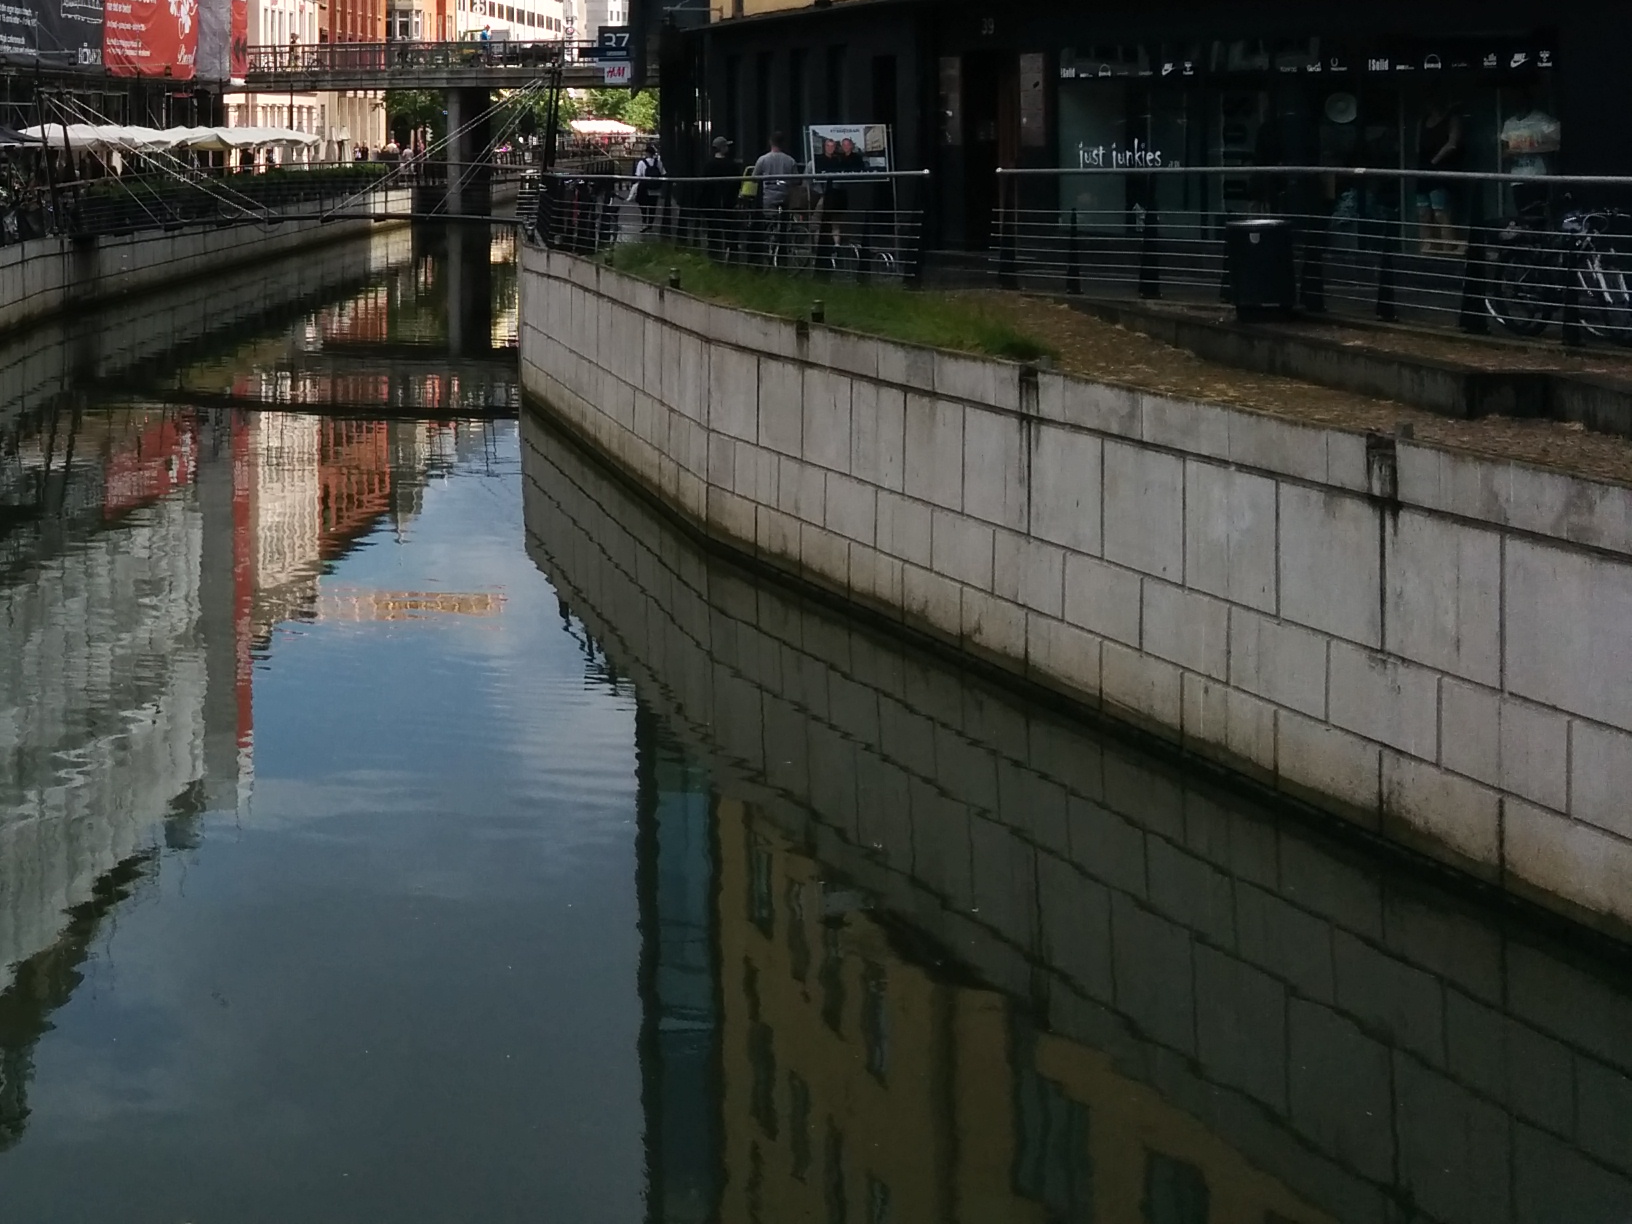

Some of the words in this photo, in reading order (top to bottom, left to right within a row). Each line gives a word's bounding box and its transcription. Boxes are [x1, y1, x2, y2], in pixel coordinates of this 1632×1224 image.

[981, 17, 995, 36] 39
[1079, 141, 1106, 169] just
[1112, 138, 1161, 169] junkies
